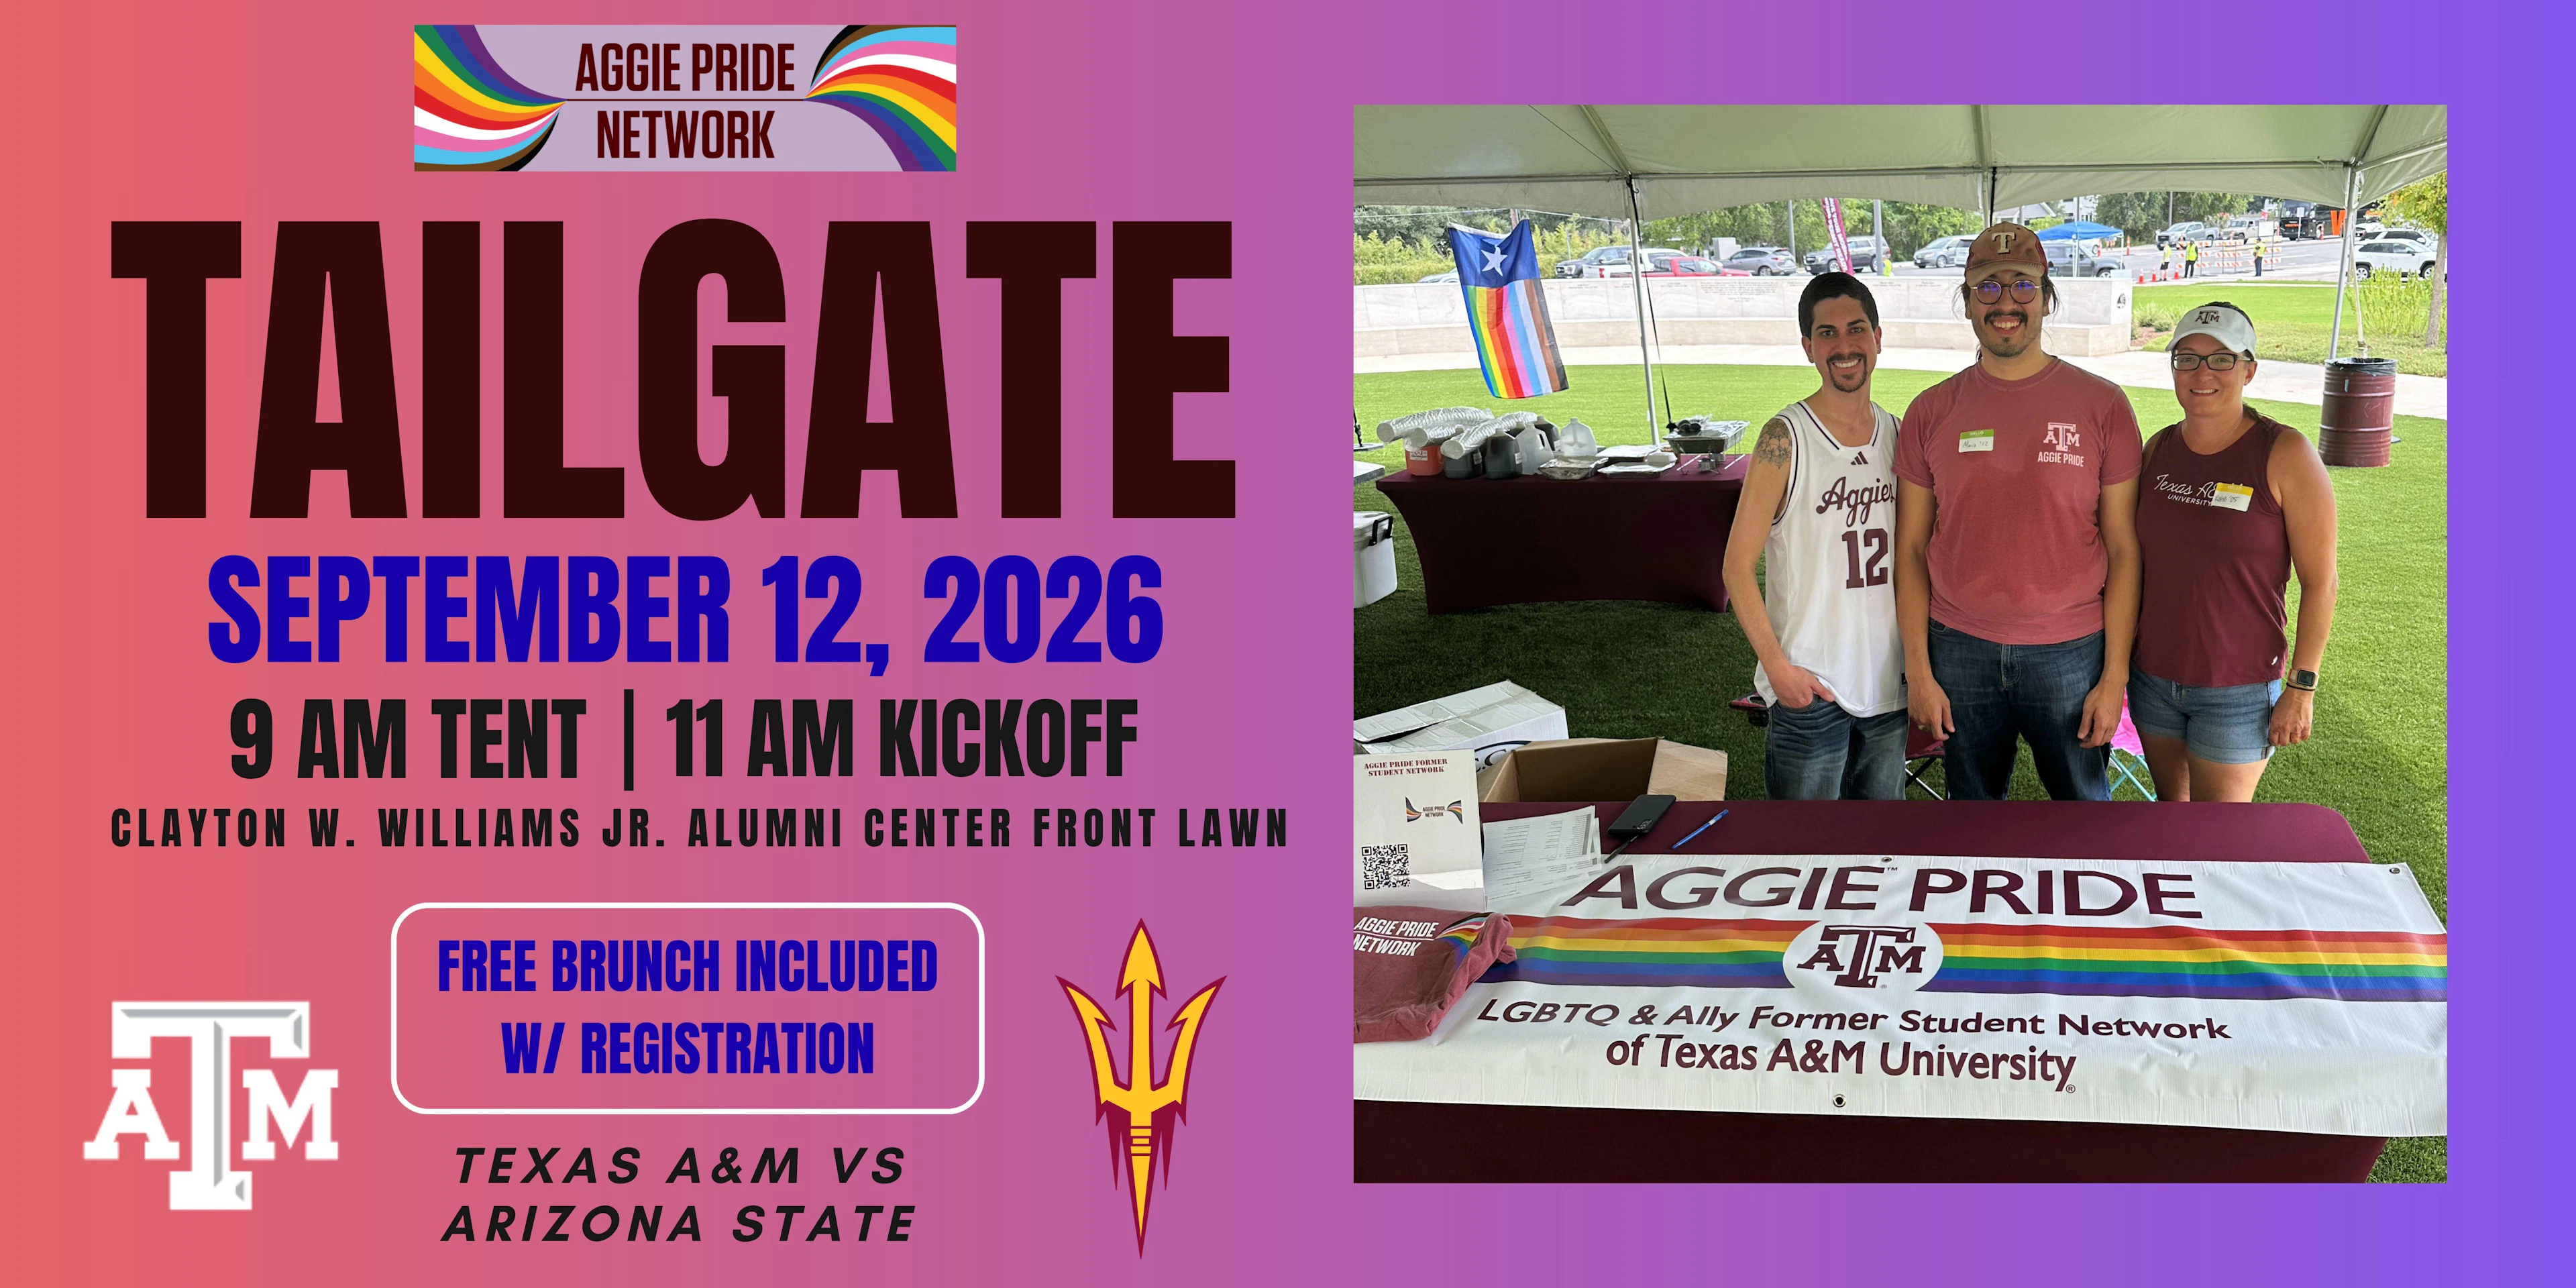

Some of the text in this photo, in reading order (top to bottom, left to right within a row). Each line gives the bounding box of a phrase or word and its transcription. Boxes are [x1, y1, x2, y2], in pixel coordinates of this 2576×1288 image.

[1828, 219, 1839, 247] PERMIT
[1833, 212, 1841, 233] YOUR
[2037, 451, 2084, 467] AGGIE PRIDE
[2154, 474, 2193, 495] Texas
[1816, 476, 1895, 527] Aggies
[2167, 493, 2213, 506] UNIVERSITY
[1841, 528, 1888, 589] 12
[1368, 766, 1444, 777] STUDENT NETWORK
[1908, 869, 2203, 918] PRIDE
[1354, 916, 1440, 937] AGGIE PRIDE
[1353, 933, 1422, 957] NETWORK
[1477, 999, 2233, 1038] LGBTQ & Ally Former Student Network
[1606, 1034, 1650, 1067] of
[1655, 1034, 1758, 1070] Texas
[1766, 1038, 1866, 1074] A&M
